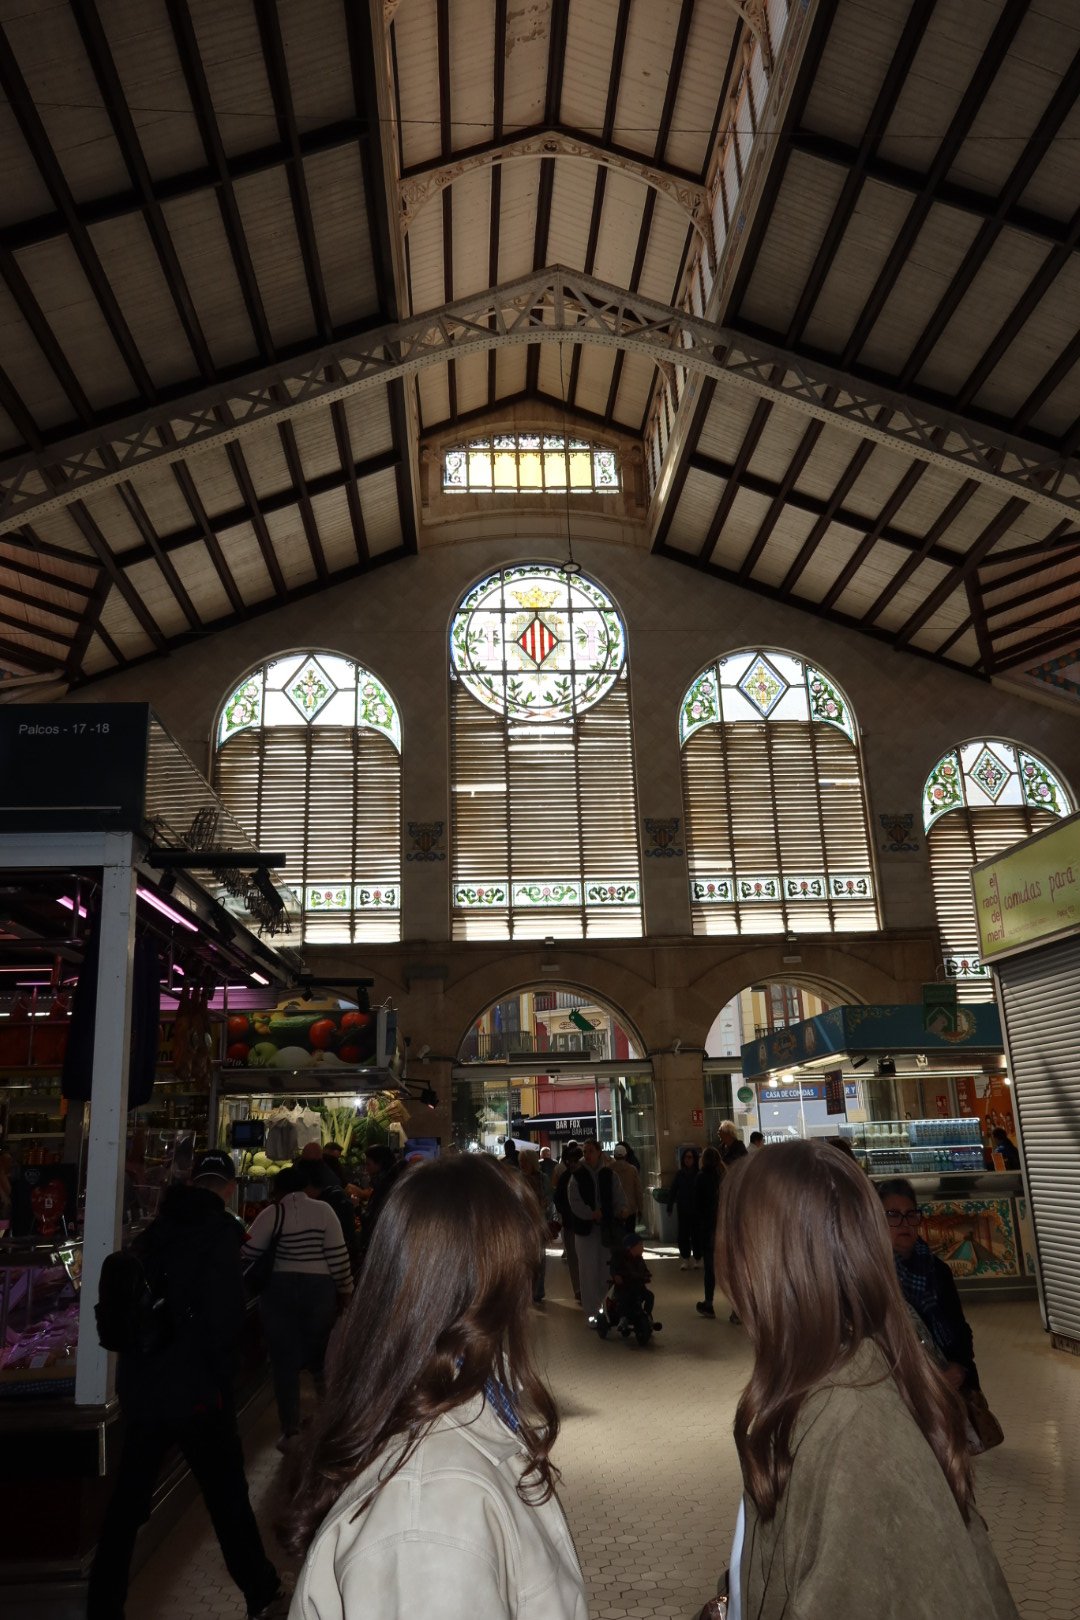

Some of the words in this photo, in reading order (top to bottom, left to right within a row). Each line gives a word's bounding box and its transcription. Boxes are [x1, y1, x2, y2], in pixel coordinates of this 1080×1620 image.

[19, 724, 59, 735] Palcos
[72, 723, 87, 734] 17
[1048, 866, 1075, 904] para
[991, 909, 1001, 923] de
[765, 1090, 780, 1098] CASA
[781, 1089, 789, 1097] DE
[790, 1088, 815, 1097] COMDAS
[555, 1120, 568, 1130] BAR
[570, 1119, 581, 1129] FOX
